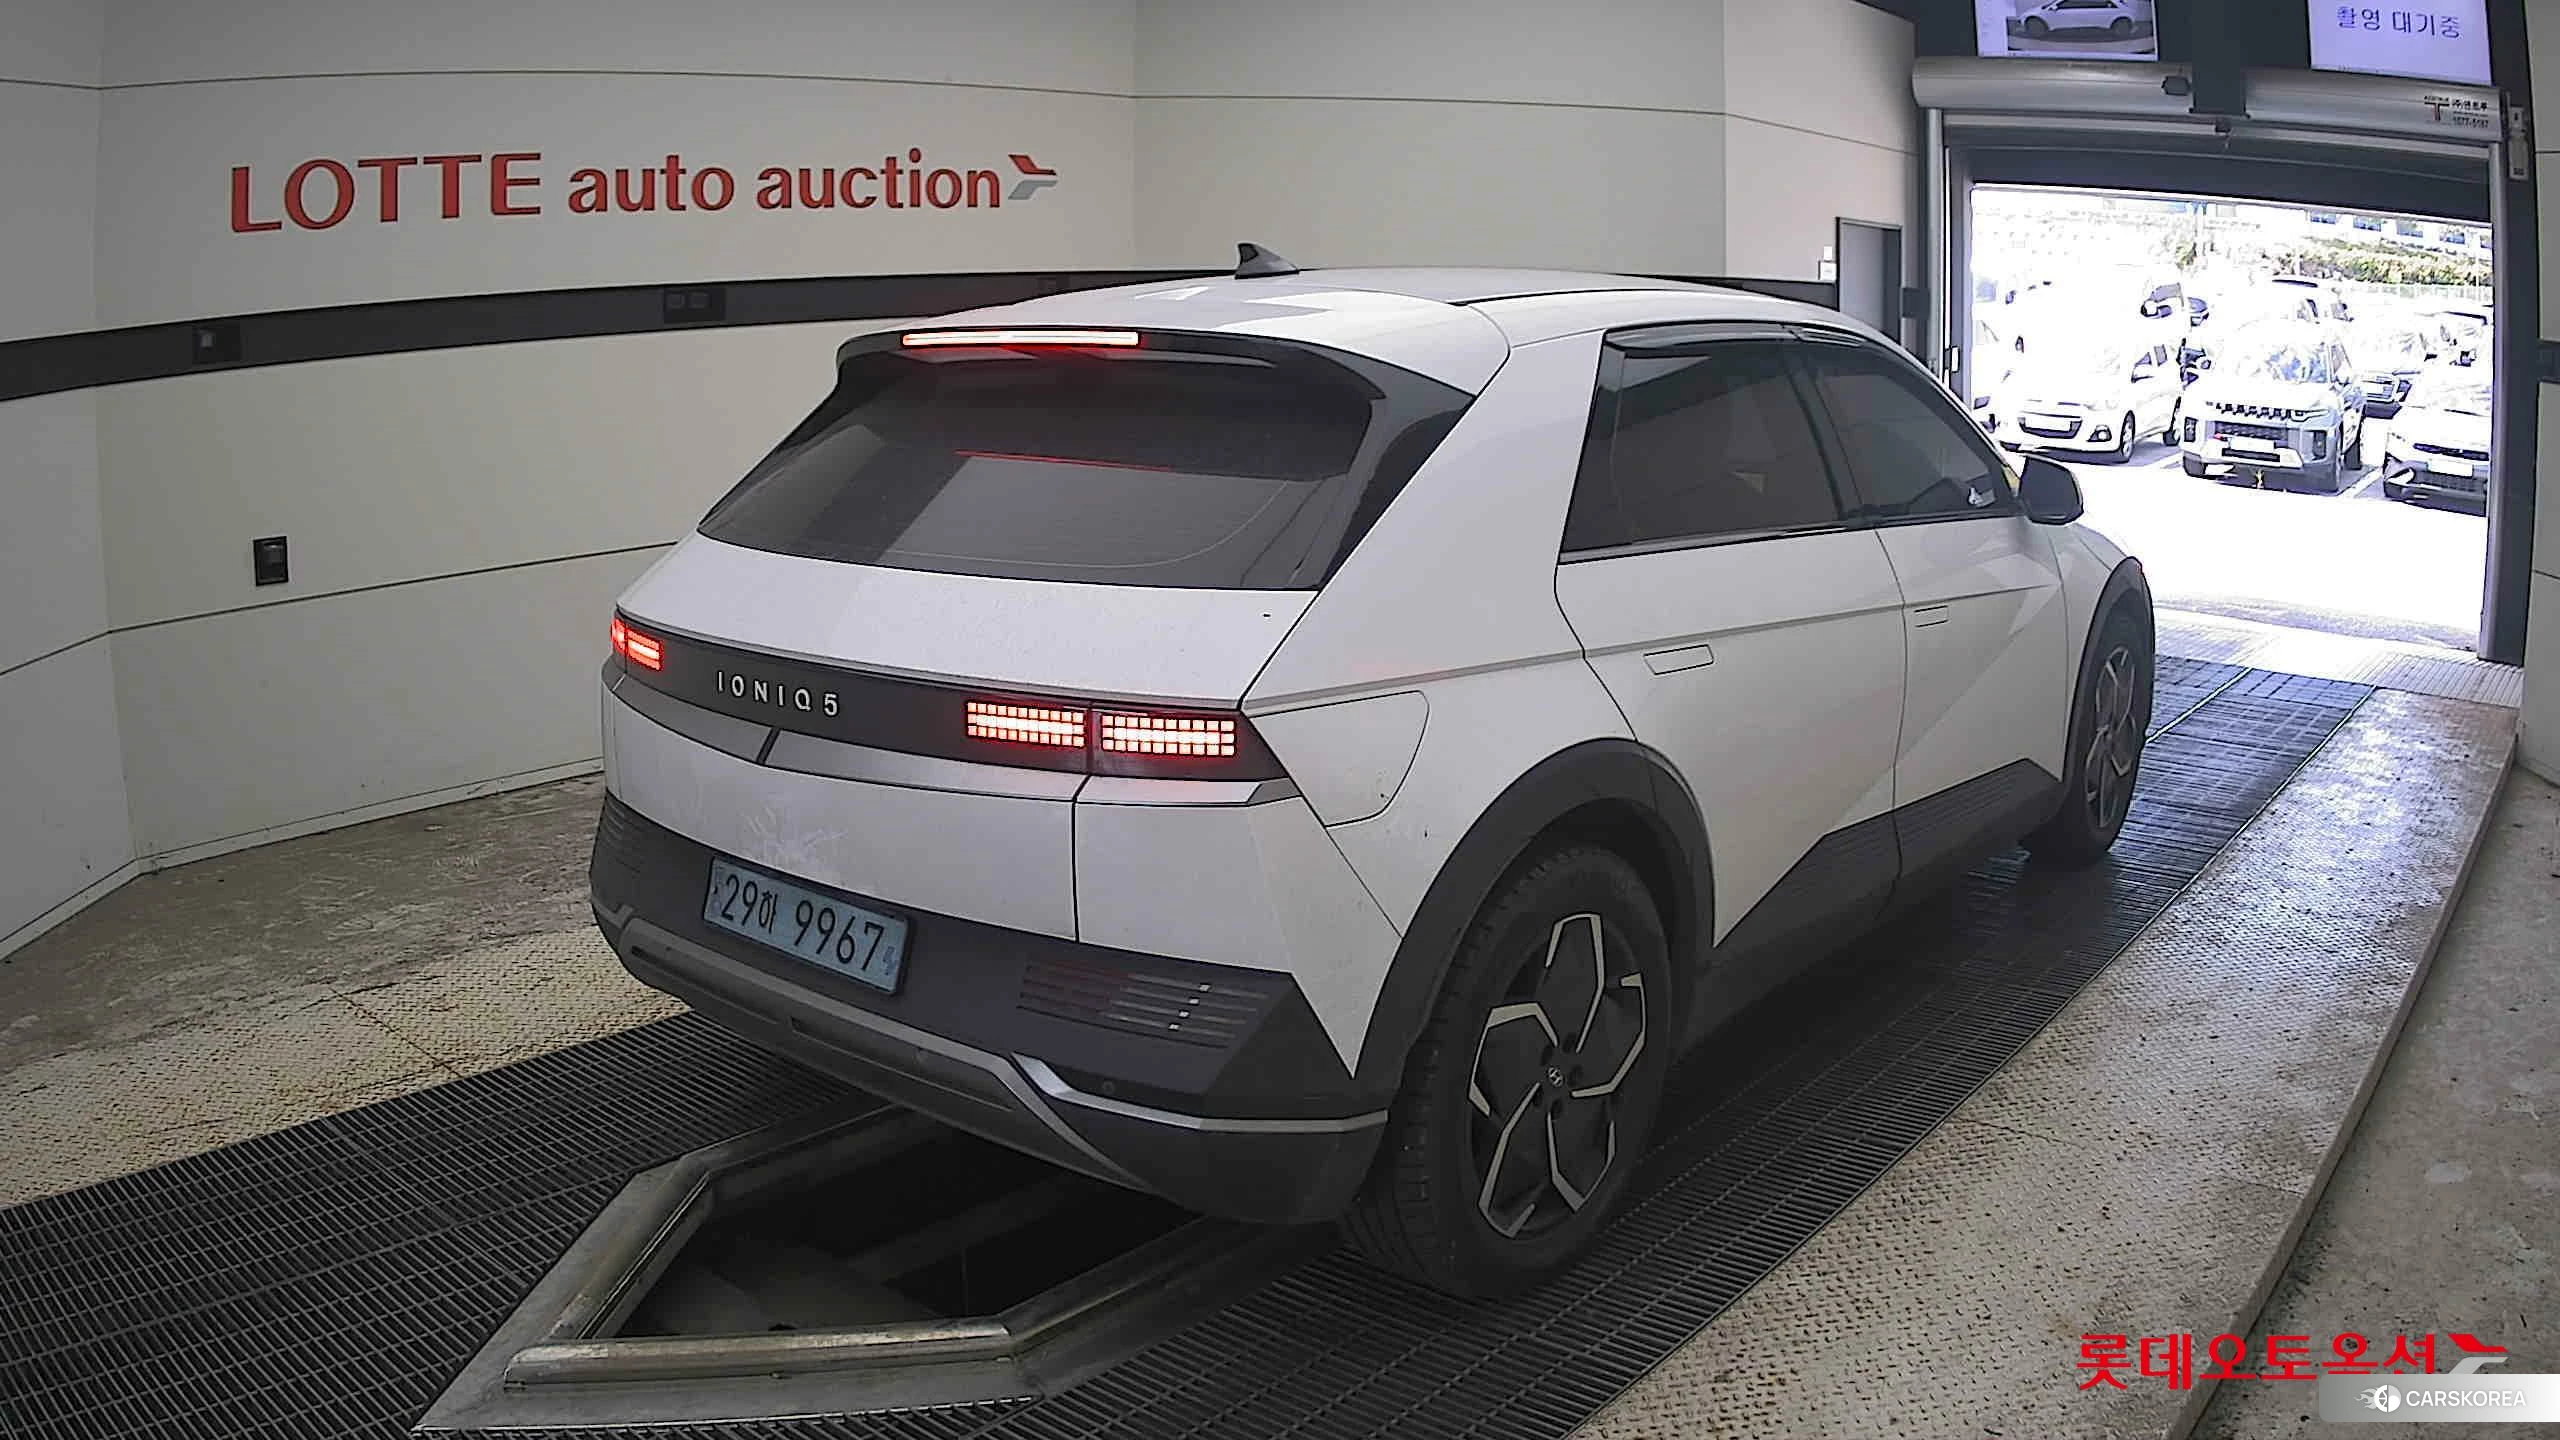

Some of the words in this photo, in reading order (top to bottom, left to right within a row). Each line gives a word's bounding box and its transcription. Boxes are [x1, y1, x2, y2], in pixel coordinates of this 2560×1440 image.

[2392, 11, 2461, 39] 대기중
[231, 152, 543, 233] LOTTE
[568, 154, 735, 214] auto
[756, 147, 1001, 211] auction
[717, 670, 812, 712] IONIQ
[823, 692, 839, 717] 5
[795, 899, 886, 972] 9967
